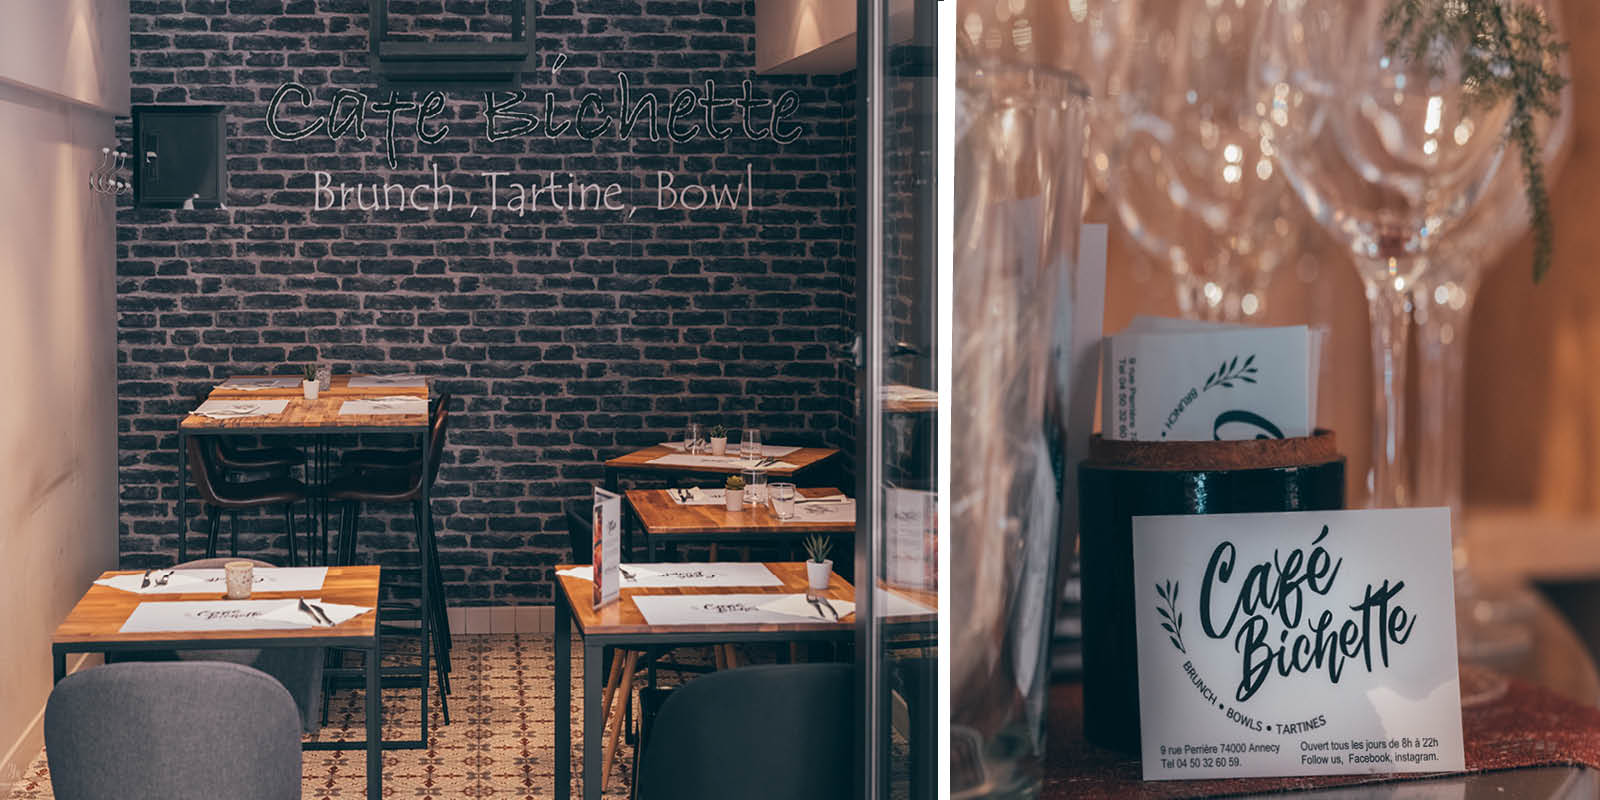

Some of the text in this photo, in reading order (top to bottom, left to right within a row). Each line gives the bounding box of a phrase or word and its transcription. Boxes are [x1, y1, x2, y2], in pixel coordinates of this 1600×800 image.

[483, 53, 802, 144] Bichette
[314, 163, 453, 211] Brunch
[656, 163, 753, 211] Bowl
[1164, 387, 1199, 430] BRUNCH
[1200, 524, 1343, 640] Café
[1234, 578, 1417, 702] Bichette
[1183, 660, 1328, 736] BRUNCH BOWLS TARTINES
[1160, 742, 1280, 755] 9 rue Perrière 74000 Annecy
[1161, 757, 1242, 768] Tel 04 50 32 60 59.
[1300, 740, 1329, 752] Ouvert
[1331, 741, 1350, 751] tous
[1351, 740, 1364, 750] les
[1365, 739, 1388, 752] jours
[1388, 739, 1400, 749] de
[1401, 738, 1413, 749] 8h
[1422, 737, 1439, 748] 22h
[1301, 754, 1329, 765] Follow
[1330, 756, 1344, 766] us,
[1348, 752, 1393, 764] Facebook,
